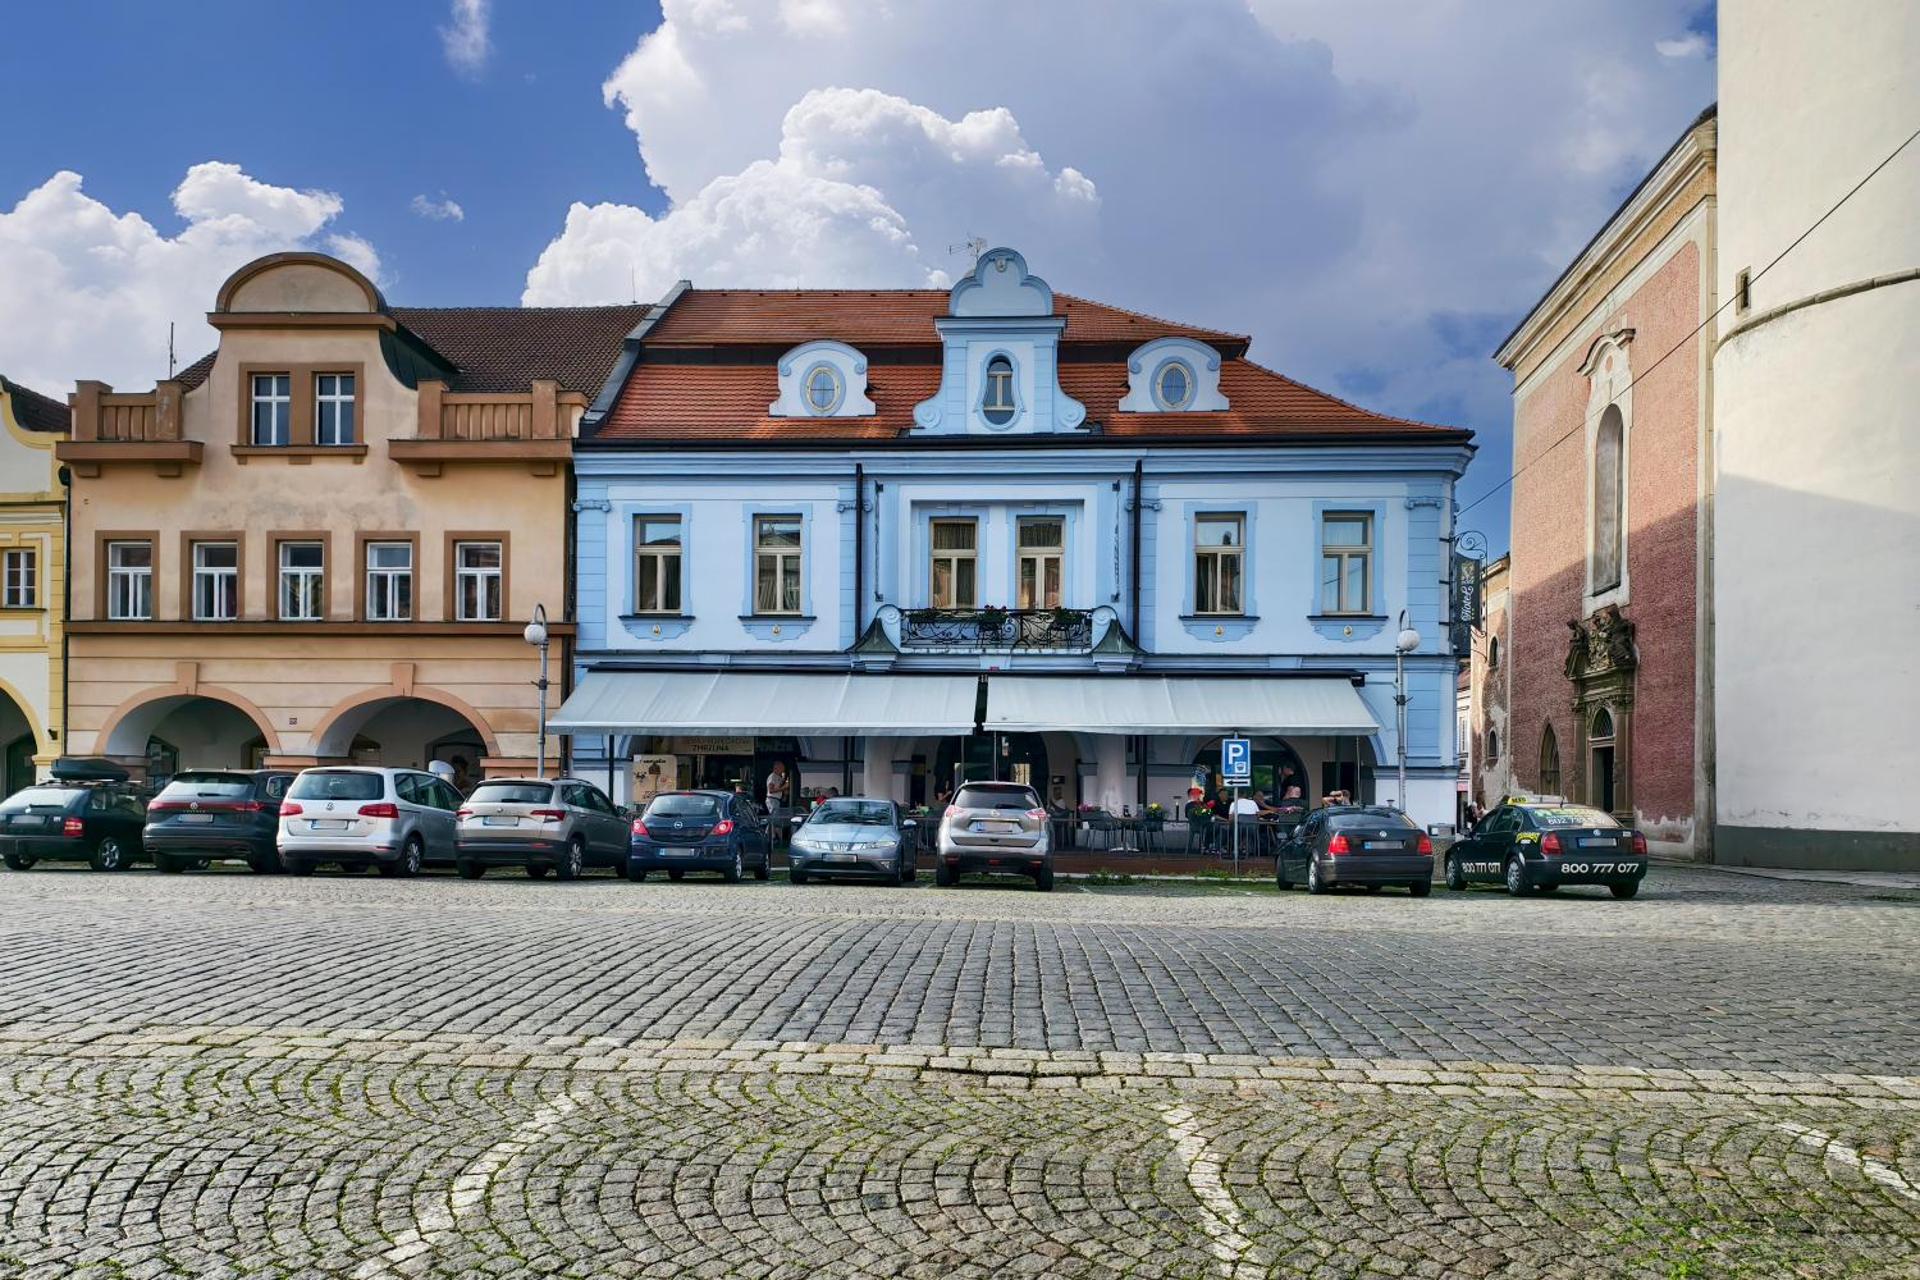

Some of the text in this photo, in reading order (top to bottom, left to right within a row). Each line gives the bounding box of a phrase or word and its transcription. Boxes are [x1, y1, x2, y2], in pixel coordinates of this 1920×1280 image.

[1228, 743, 1244, 765] P
[1462, 862, 1501, 874] 800 777 077
[1561, 863, 1640, 874] 800 777 077
